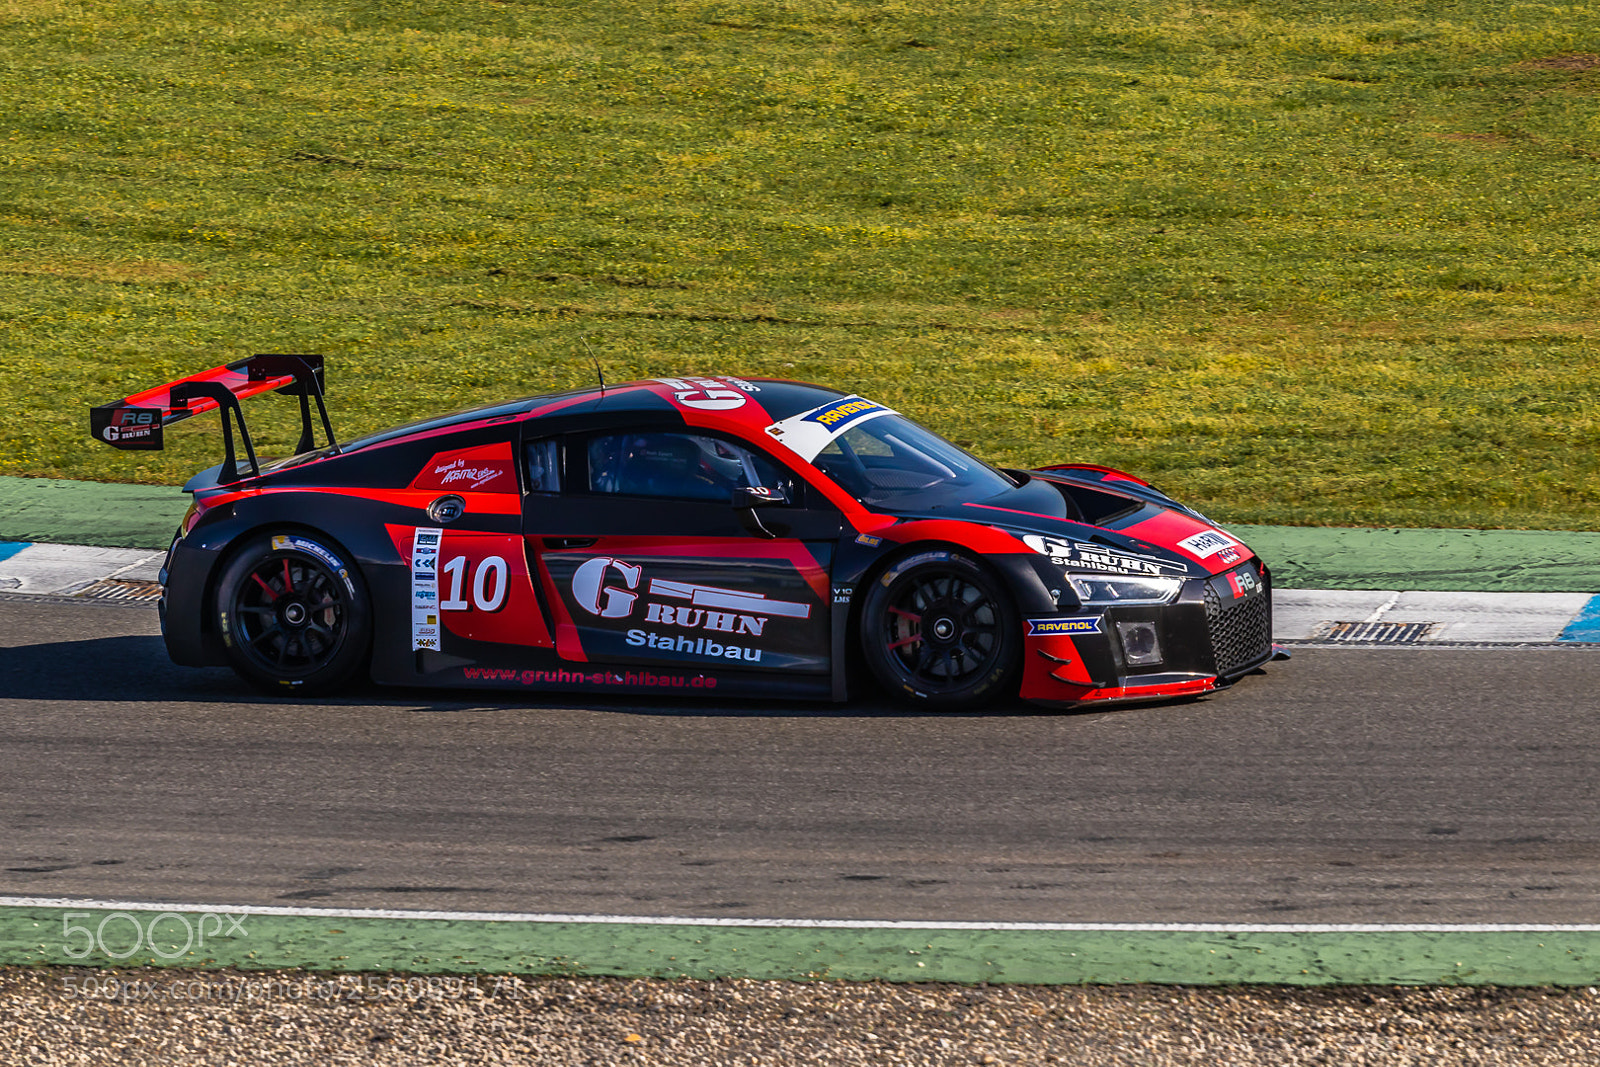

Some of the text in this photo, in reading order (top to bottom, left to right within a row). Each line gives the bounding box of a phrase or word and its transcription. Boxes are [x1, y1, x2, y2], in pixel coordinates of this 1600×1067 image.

[121, 412, 153, 424] R8
[816, 401, 877, 425] RAVENOL
[294, 539, 341, 567] MICHELIN
[1050, 557, 1129, 575] Stahlbau
[440, 555, 509, 612] 10
[1234, 572, 1255, 593] R8
[1037, 622, 1093, 631] RAVENOL
[625, 628, 763, 662] Stahlbau
[463, 667, 718, 689] www.gruhn-stahlbau.de
